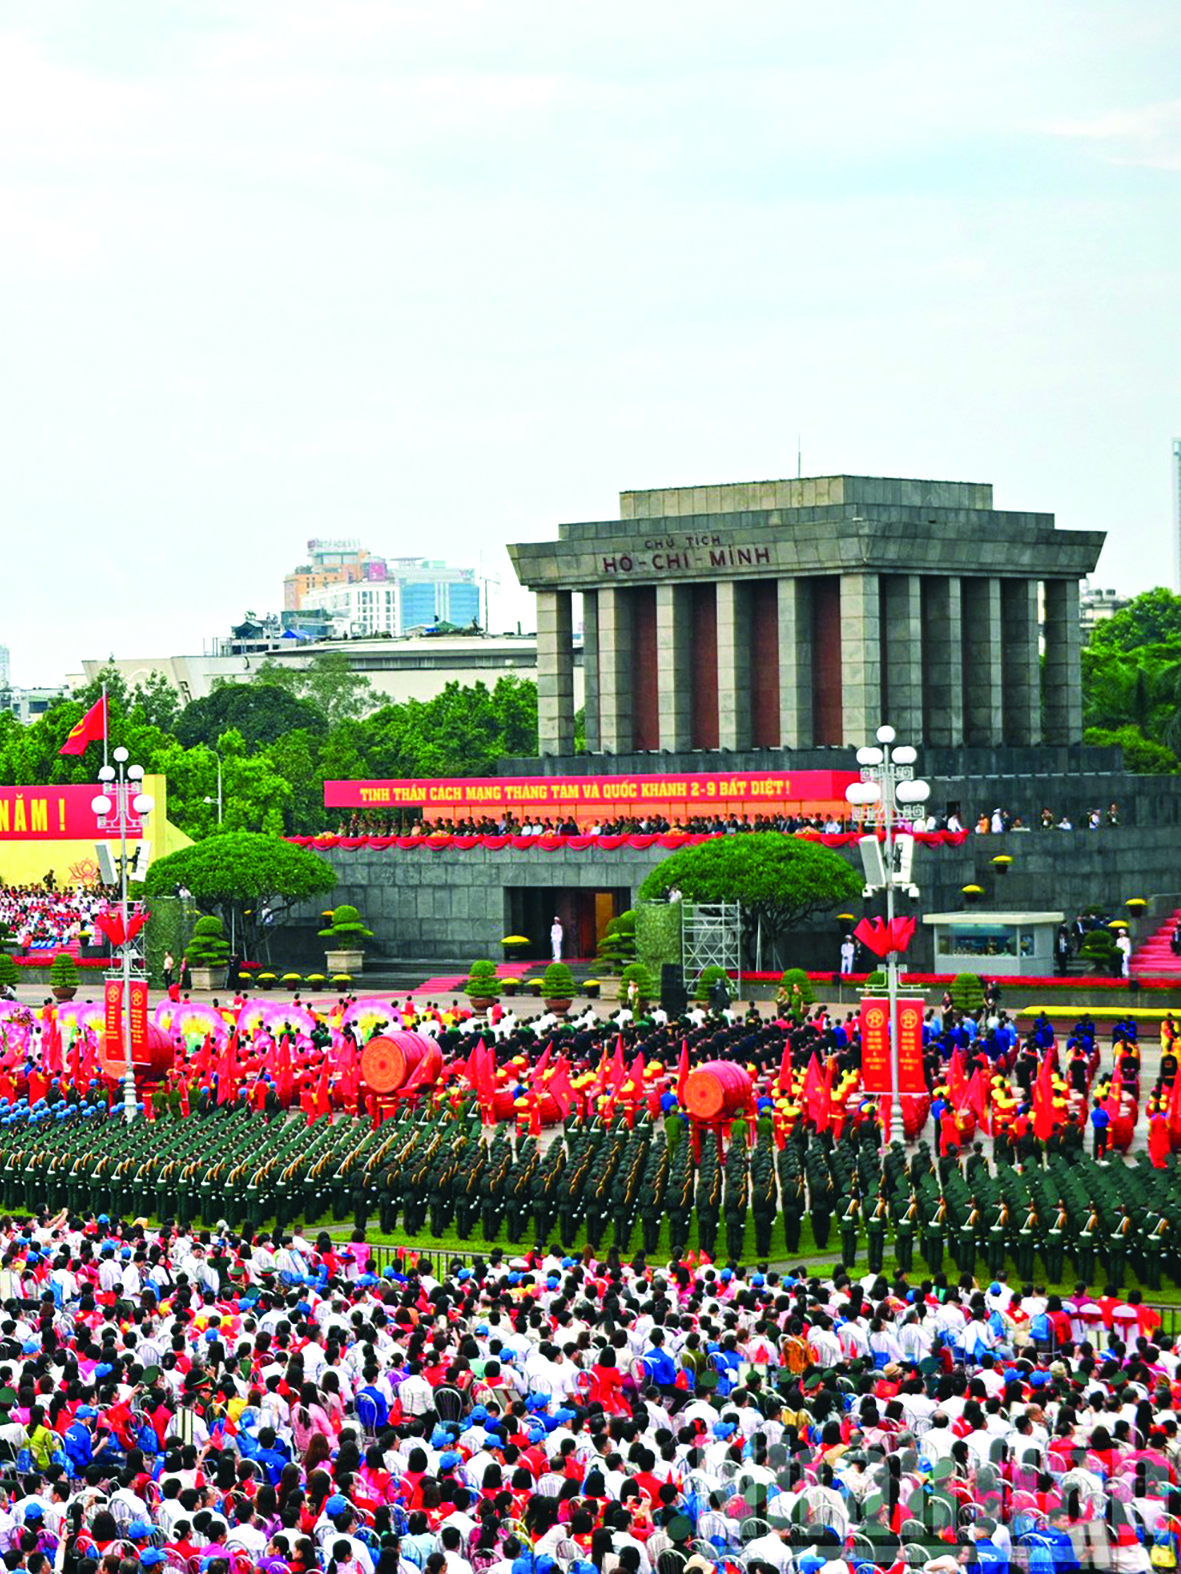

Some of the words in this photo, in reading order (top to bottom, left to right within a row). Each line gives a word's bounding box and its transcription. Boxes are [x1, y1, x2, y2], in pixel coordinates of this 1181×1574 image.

[360, 787, 390, 802] TINH
[430, 784, 462, 801] CÁCH
[465, 785, 502, 802] MẠNG
[504, 782, 547, 800] THÁNG
[550, 781, 580, 799] TÁM
[582, 781, 600, 799] VÀ
[603, 780, 637, 800] QUỐC
[641, 780, 687, 797] KHÁNH
[719, 777, 747, 796] BẤT
